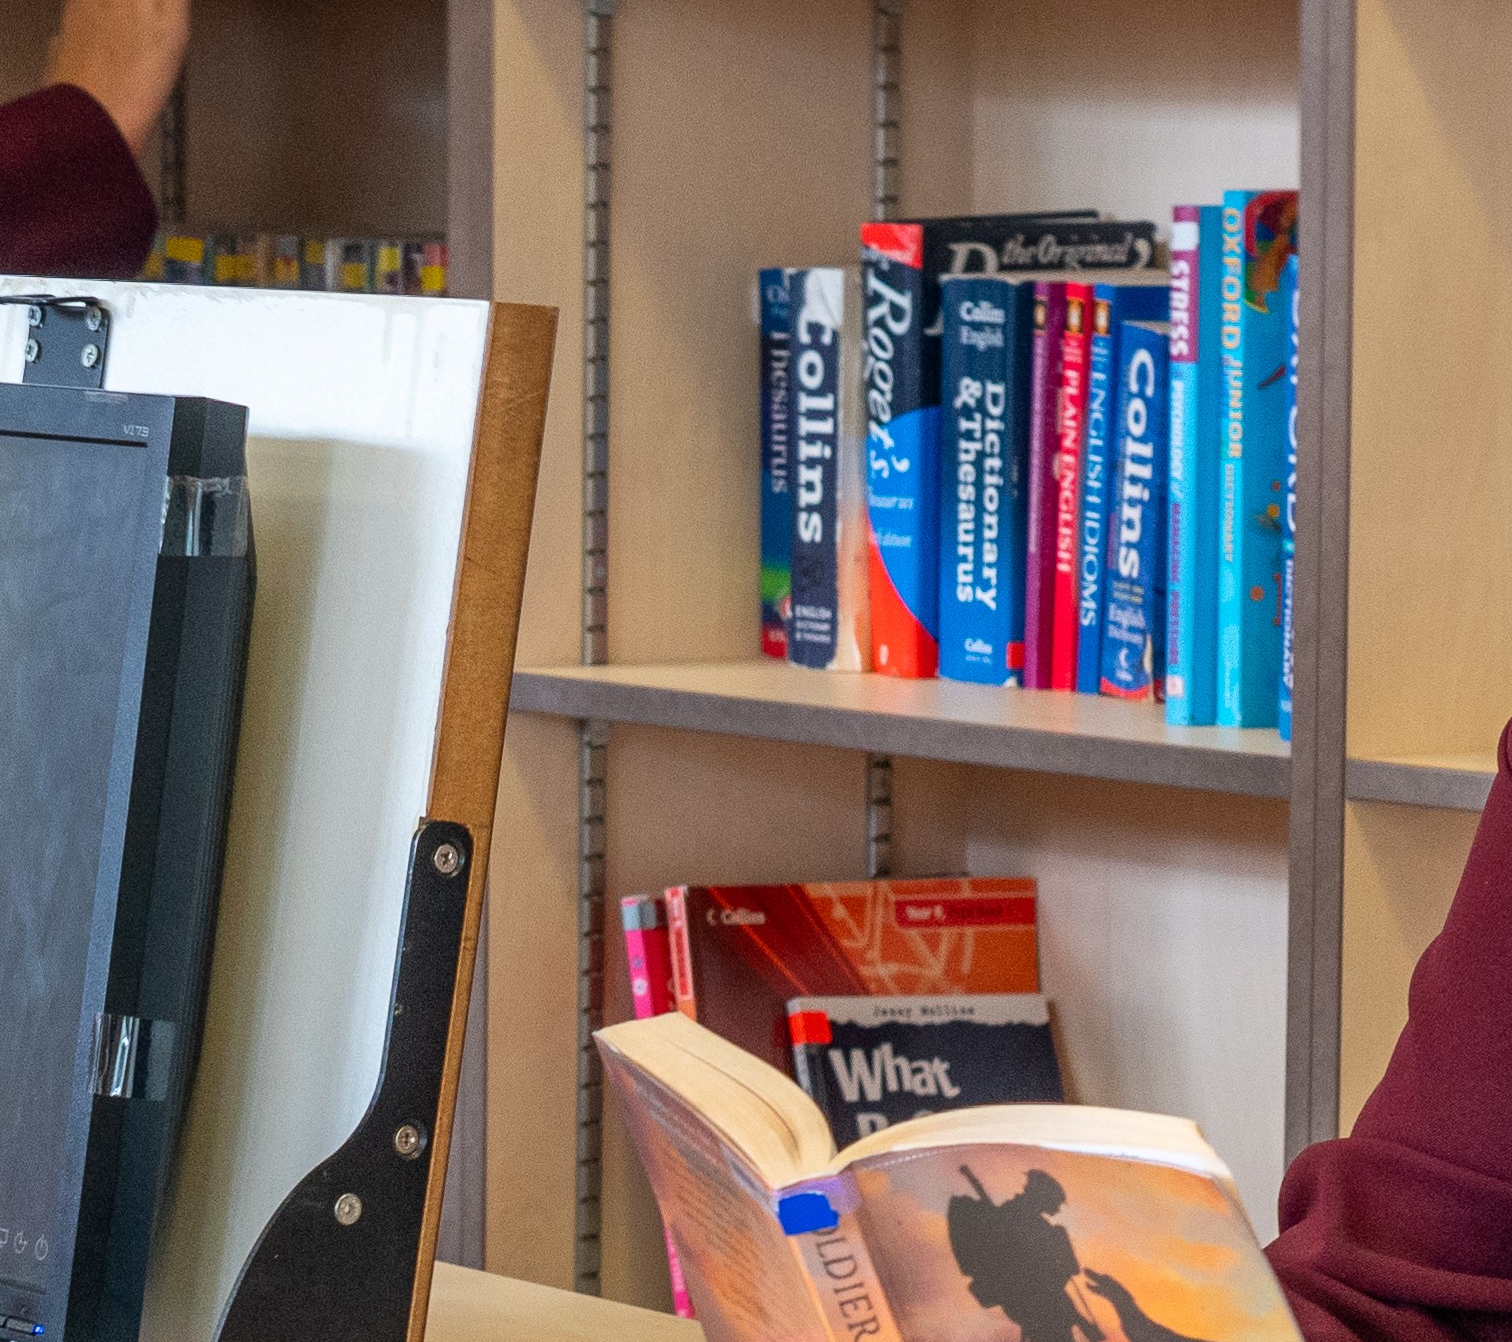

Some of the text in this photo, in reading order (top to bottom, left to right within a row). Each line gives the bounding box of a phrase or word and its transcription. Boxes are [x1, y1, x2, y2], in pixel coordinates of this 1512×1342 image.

[1170, 260, 1190, 357] STRESS
[1222, 208, 1242, 350] OXFORD
[797, 316, 836, 544] Collins
[862, 271, 913, 479] Roget's
[1062, 370, 1081, 447] PLAIN
[1085, 370, 1109, 502] ENGLISH
[1226, 356, 1243, 459] JUNIOR
[976, 380, 1007, 610] Dictionary
[1056, 455, 1077, 572] ENGLISH
[1117, 348, 1155, 578] Collins
[1079, 511, 1101, 626] IDIOMS
[828, 1042, 960, 1103] What
